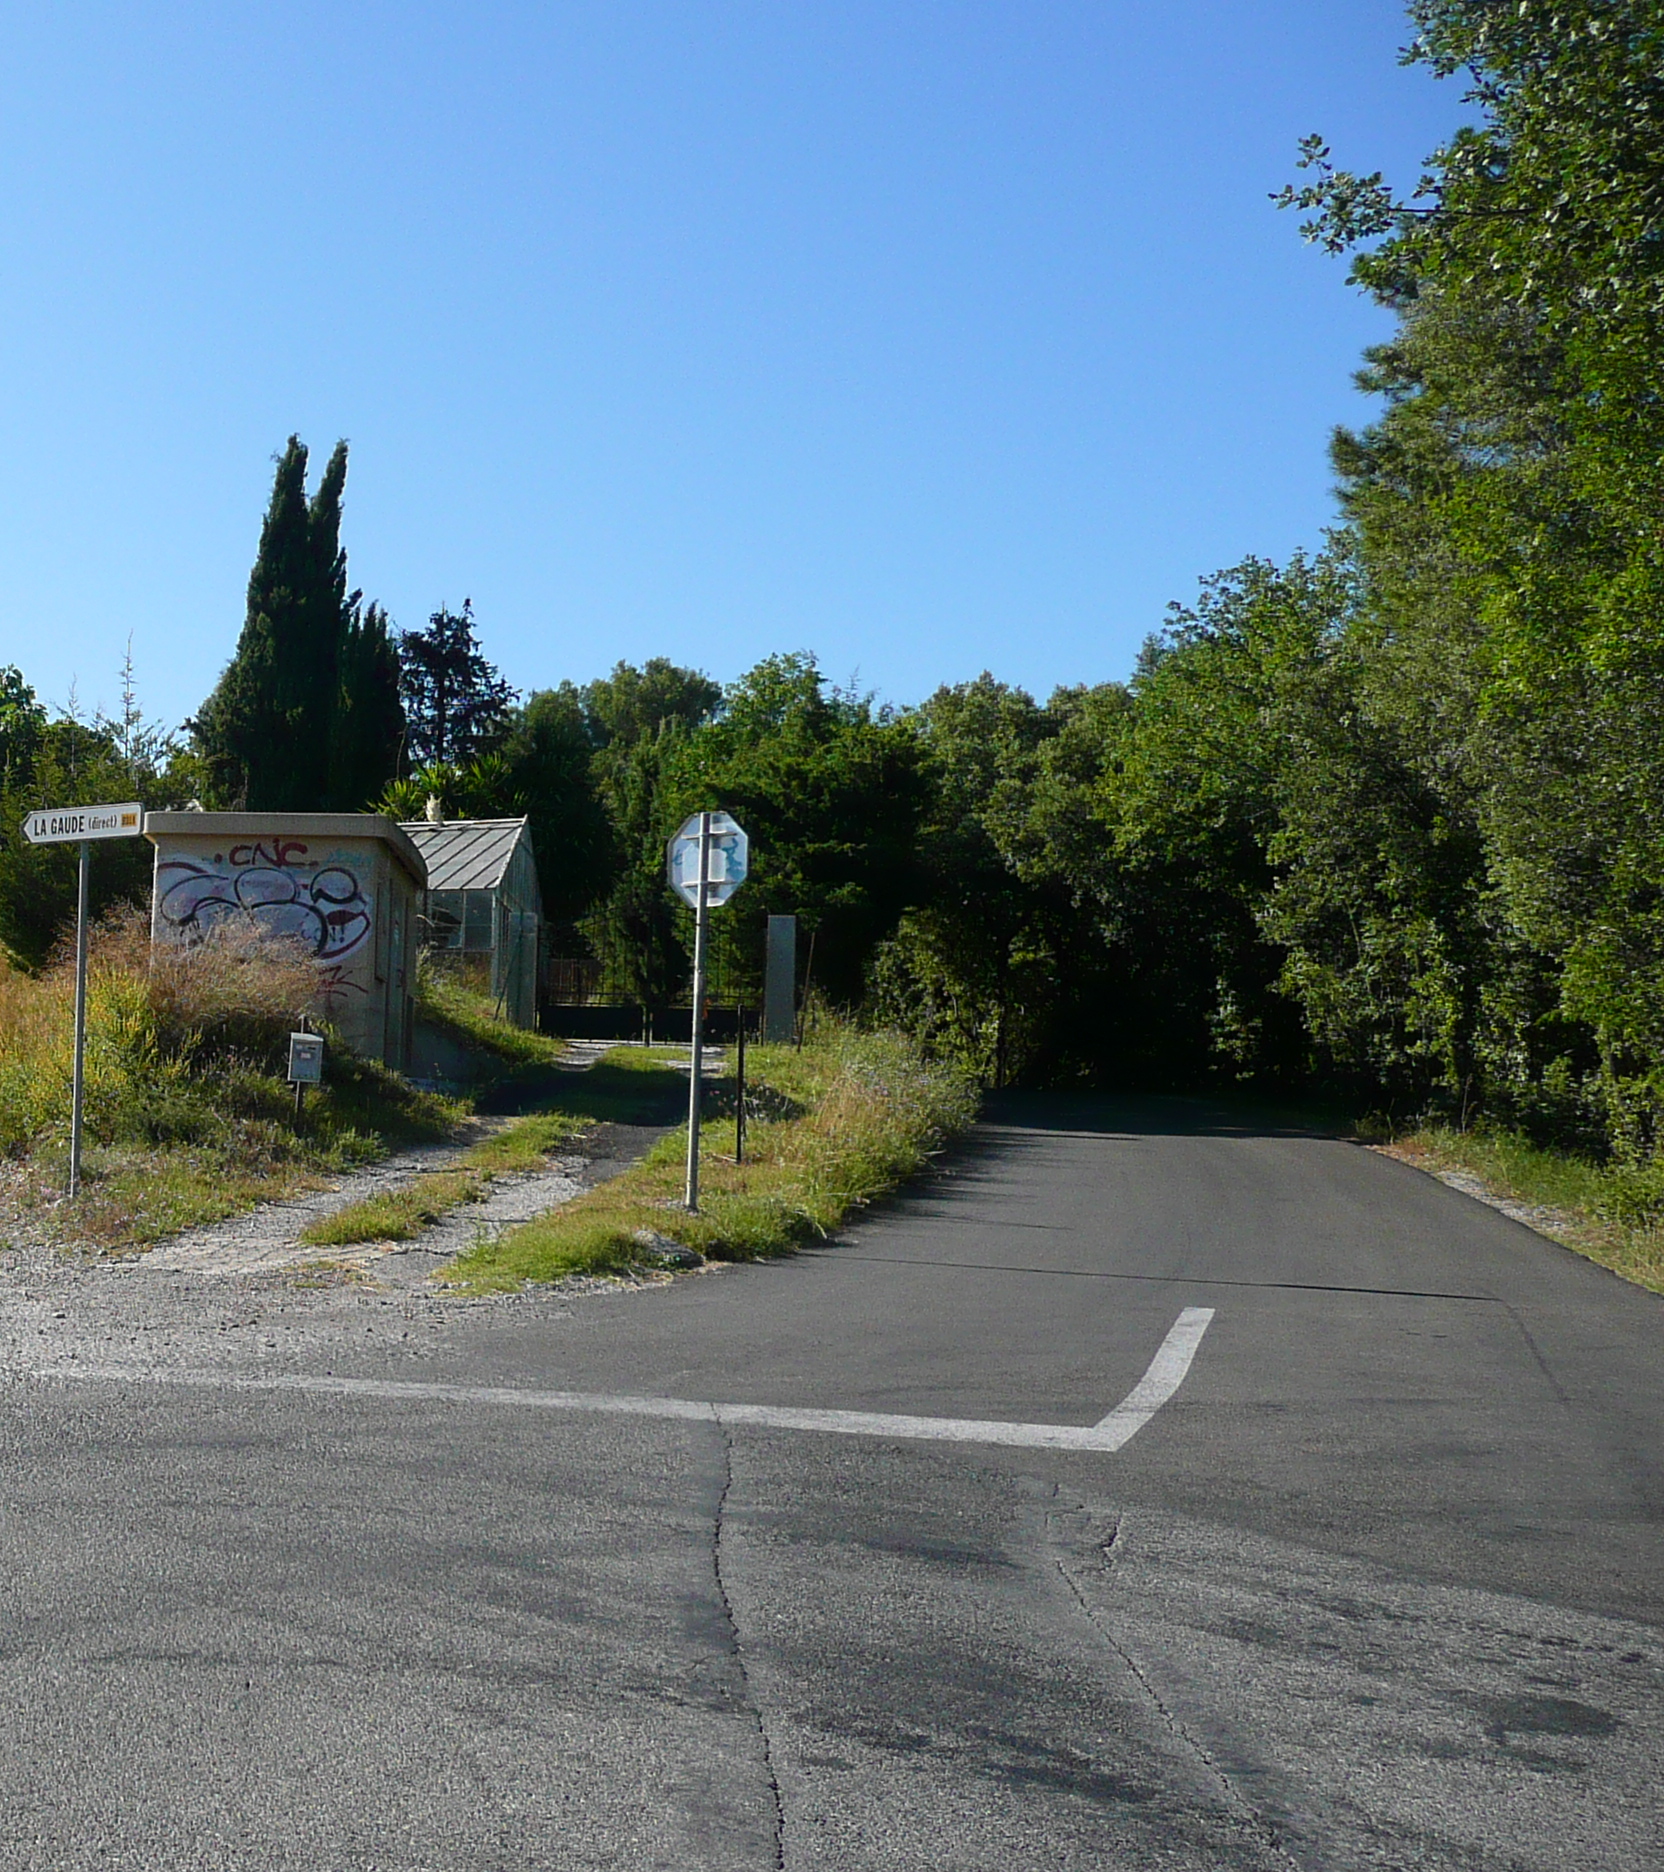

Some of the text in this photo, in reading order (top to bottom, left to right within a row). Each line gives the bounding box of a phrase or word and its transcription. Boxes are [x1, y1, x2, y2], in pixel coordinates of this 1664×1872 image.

[34, 819, 47, 836] LA
[51, 816, 85, 835] GAUDE
[88, 814, 118, 830] (direct)
